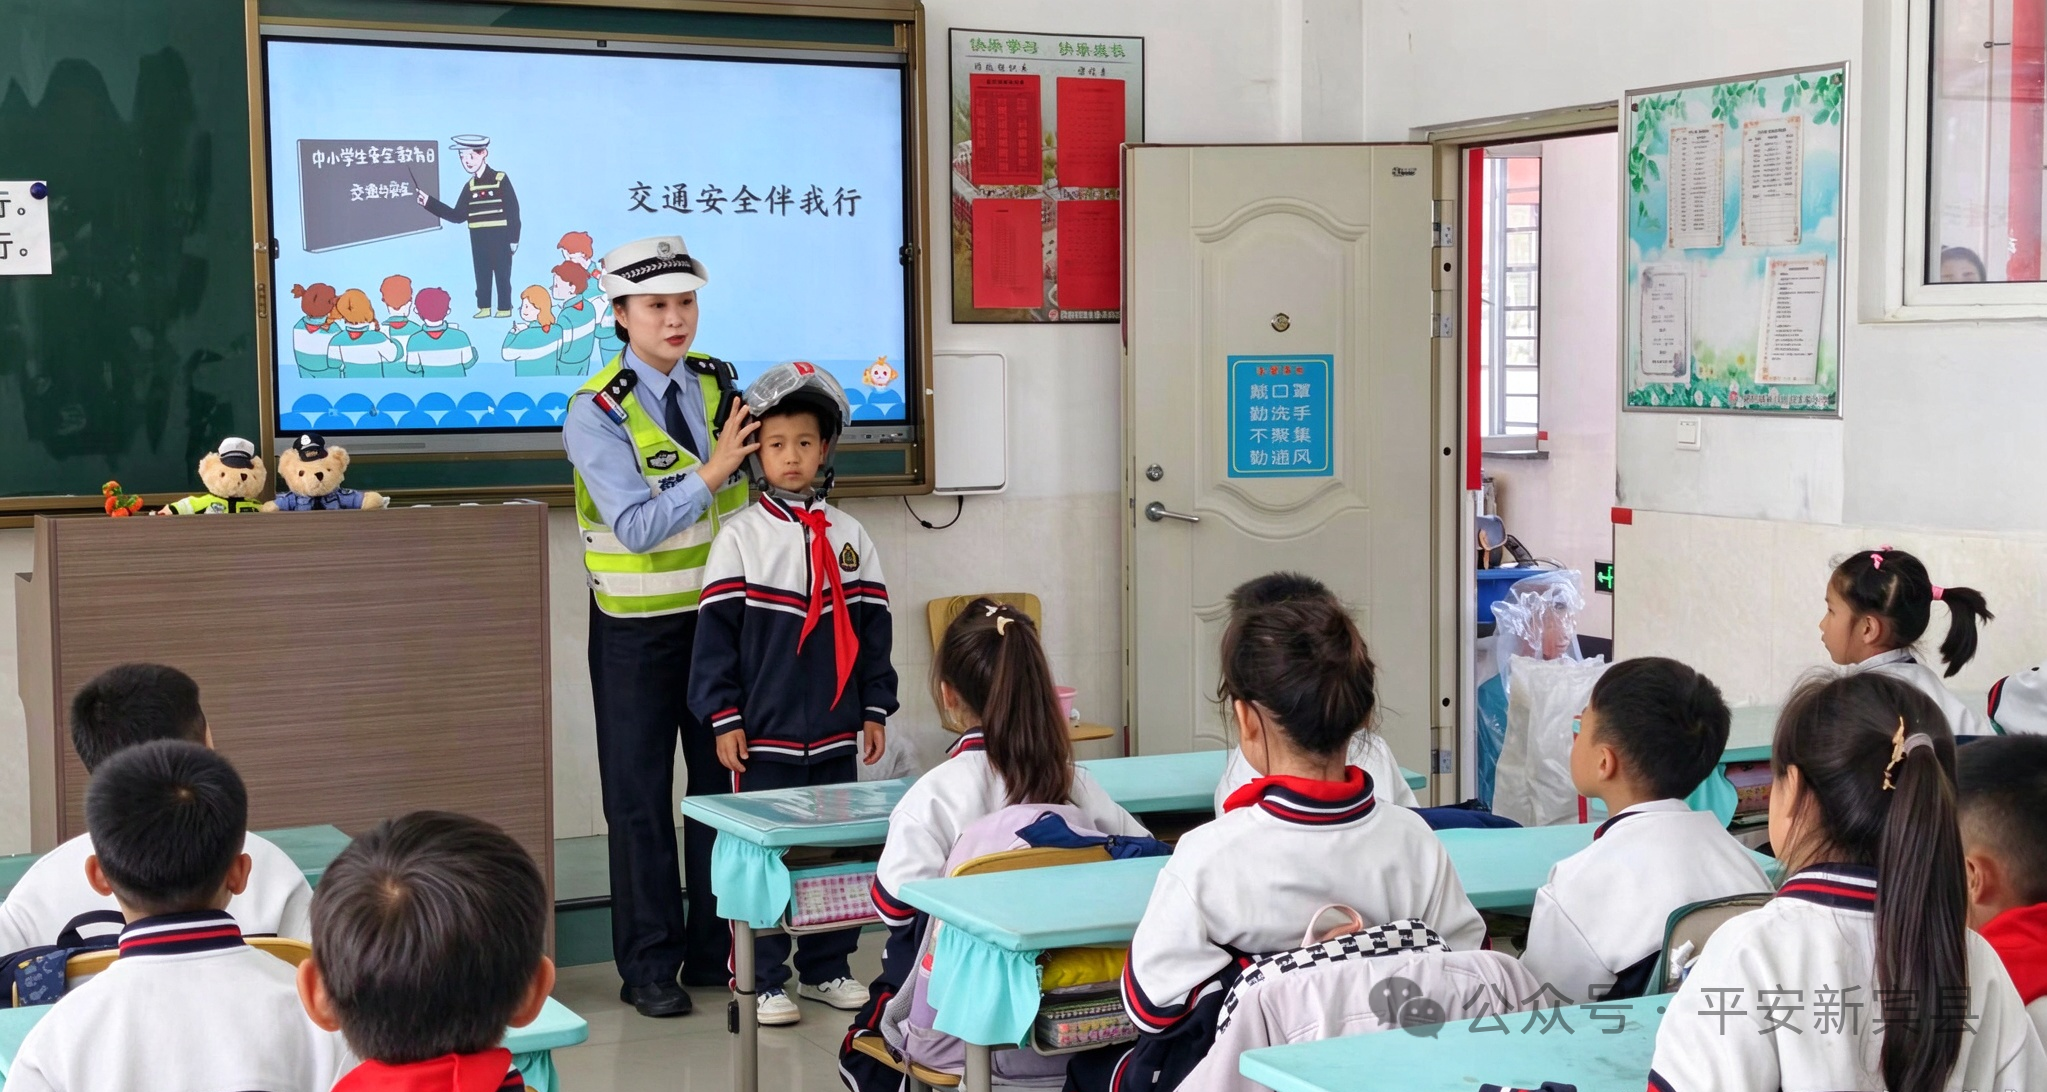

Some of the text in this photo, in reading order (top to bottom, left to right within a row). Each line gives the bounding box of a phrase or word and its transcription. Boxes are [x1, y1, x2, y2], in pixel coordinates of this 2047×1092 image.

[627, 180, 862, 217] 交通安全伴我行
[1250, 383, 1311, 400] 戴口罩
[1250, 405, 1312, 421] 勤洗手
[1250, 427, 1311, 443] 不聚集
[1250, 449, 1312, 465] 勤通风
